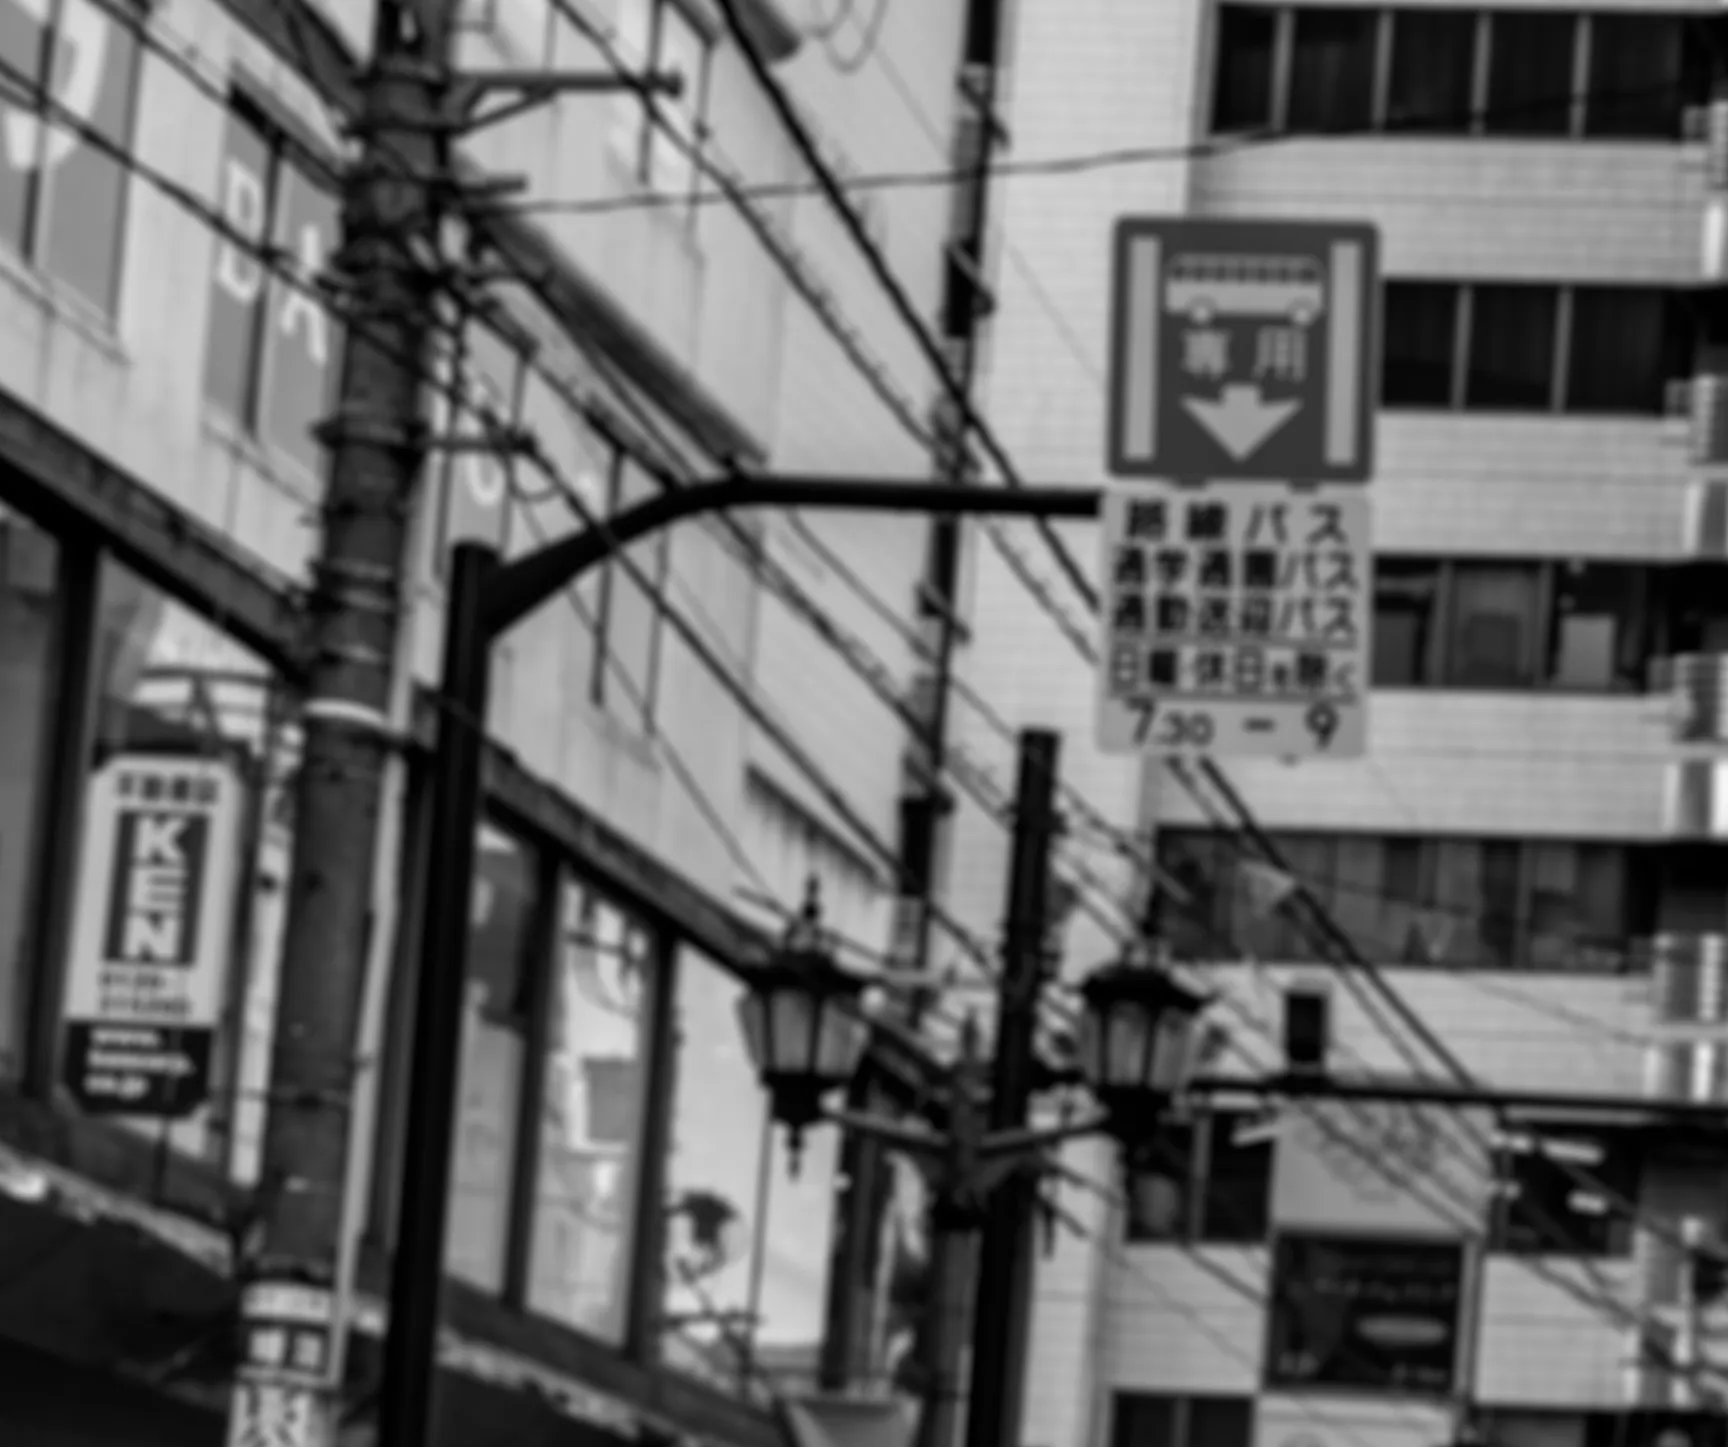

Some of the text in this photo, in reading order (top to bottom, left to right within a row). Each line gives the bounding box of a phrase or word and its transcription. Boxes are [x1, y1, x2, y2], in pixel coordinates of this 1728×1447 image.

[1124, 500, 1349, 545] 路線バス
[1304, 702, 1340, 751] 9
[121, 814, 190, 962] KEN
